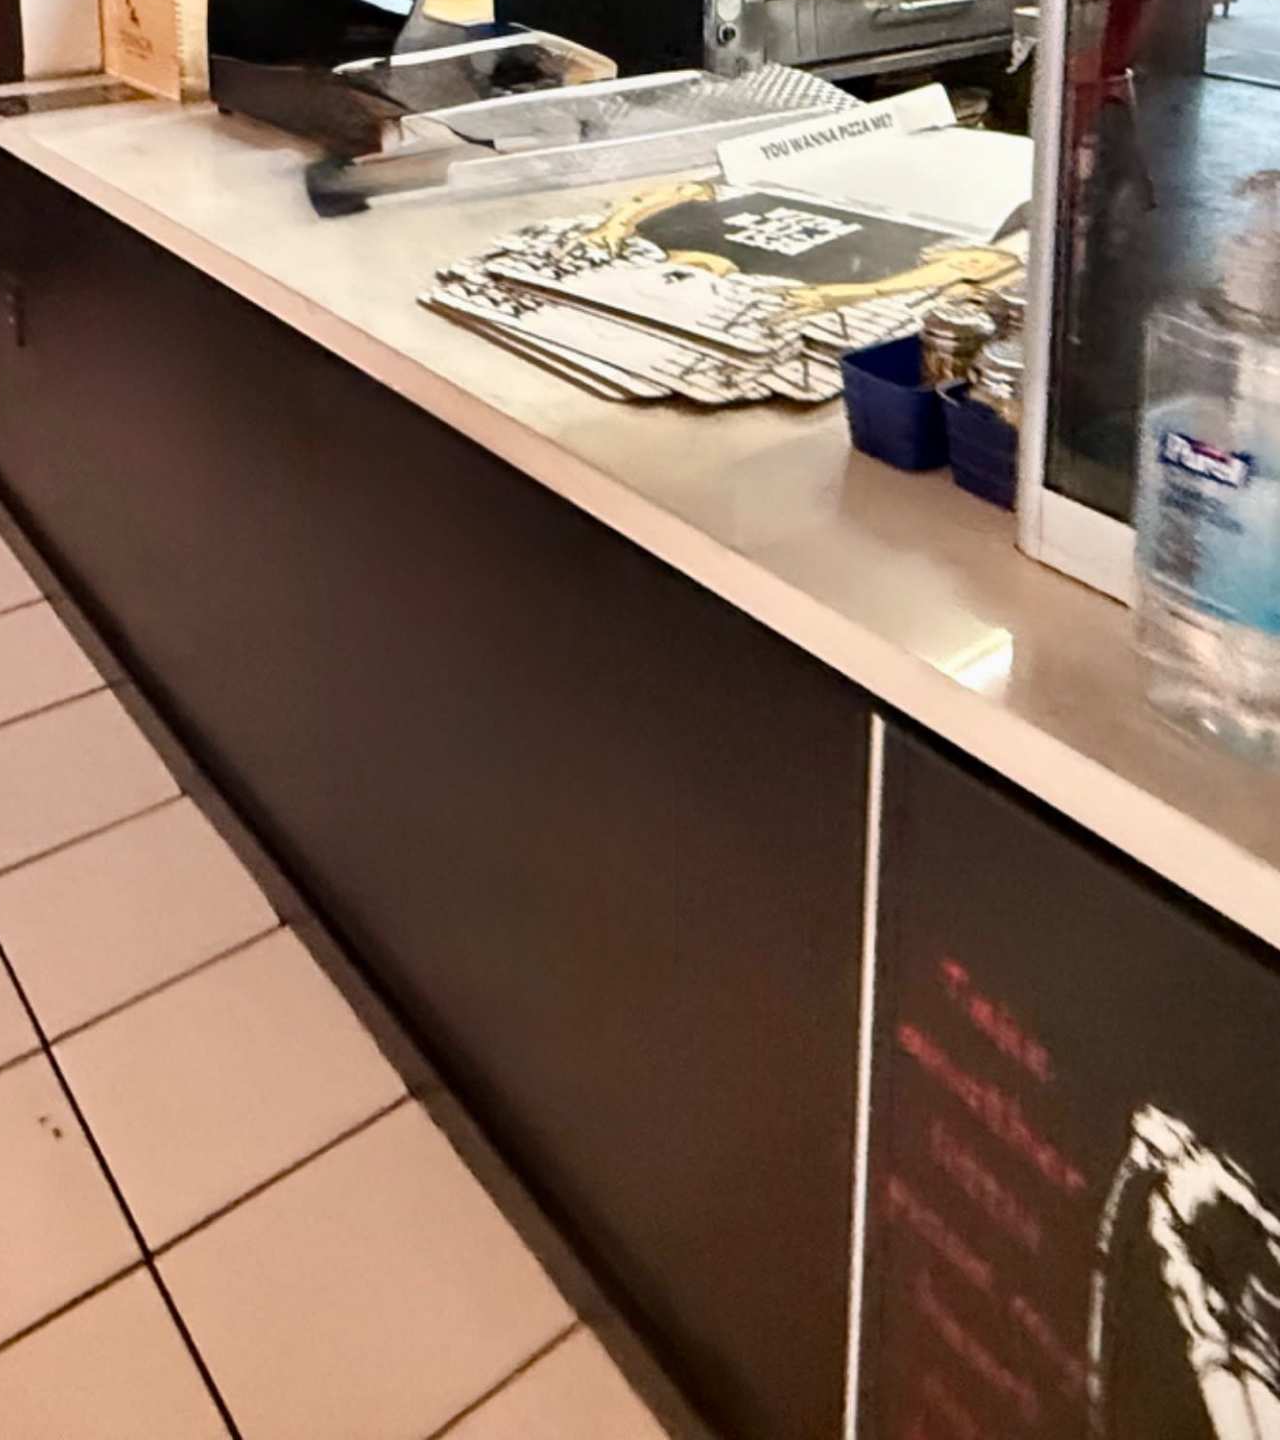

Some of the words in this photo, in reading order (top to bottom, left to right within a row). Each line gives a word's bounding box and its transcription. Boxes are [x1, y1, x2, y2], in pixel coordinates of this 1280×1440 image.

[759, 139, 791, 160] YOU
[788, 127, 839, 153] WANNA
[837, 119, 872, 140] PIZZA
